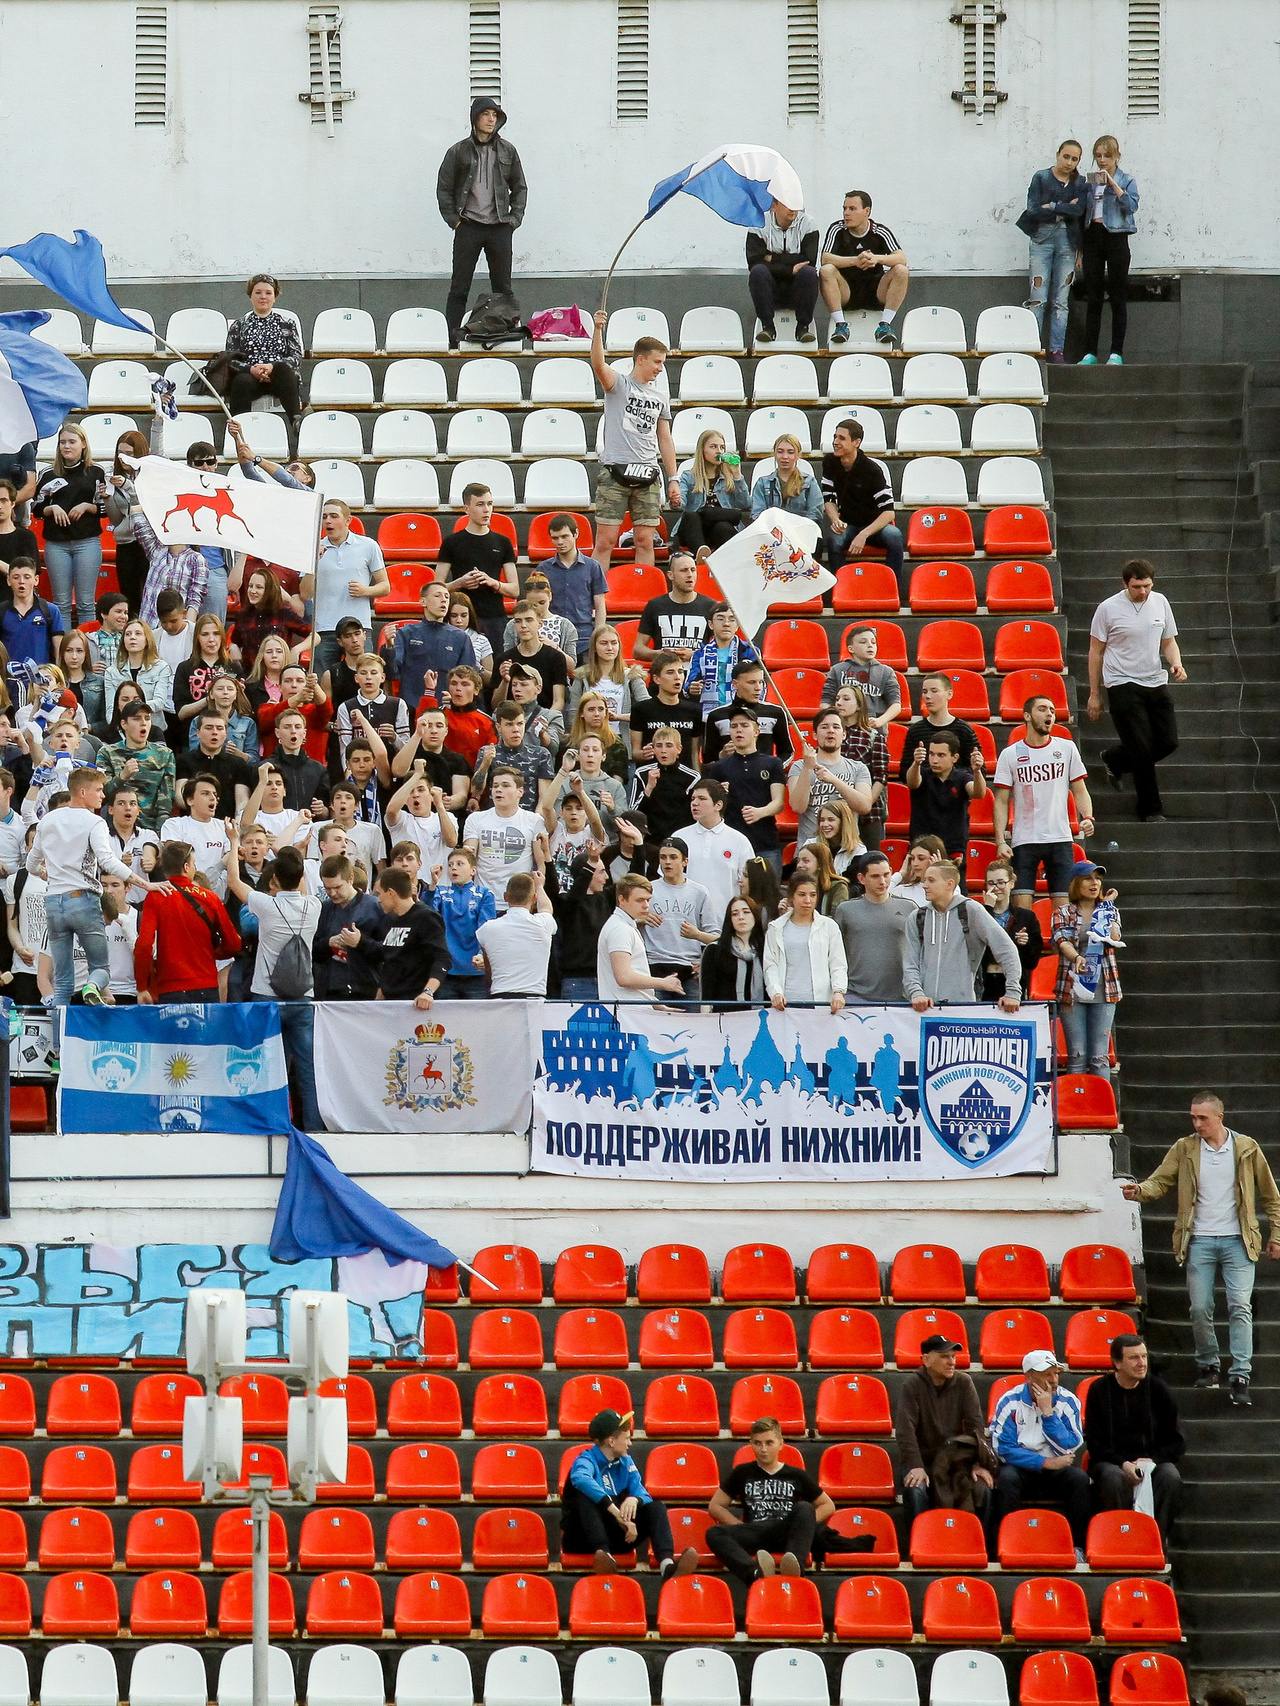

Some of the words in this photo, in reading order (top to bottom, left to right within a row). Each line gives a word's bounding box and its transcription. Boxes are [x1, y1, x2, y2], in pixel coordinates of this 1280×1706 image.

[627, 396, 661, 412] TEAM
[625, 405, 656, 426] adidas
[624, 463, 653, 480] NIKE
[1016, 762, 1065, 784] RUSSIA
[812, 795, 829, 807] ME
[382, 926, 412, 947] NIKE
[938, 1024, 998, 1036] ФУТБОЛЬНЫЙ
[999, 1026, 1022, 1037] КЛУБ
[925, 1034, 1030, 1080] ОЛИМПИЕЦ
[930, 1066, 972, 1092] НИЖНИЙ
[973, 1067, 1024, 1096] НОВГОРОД
[545, 1118, 771, 1168] ПОДДЕРЖИВАЙ
[781, 1116, 922, 1164] НИЖНИЙ!
[763, 1479, 796, 1498] KIND
